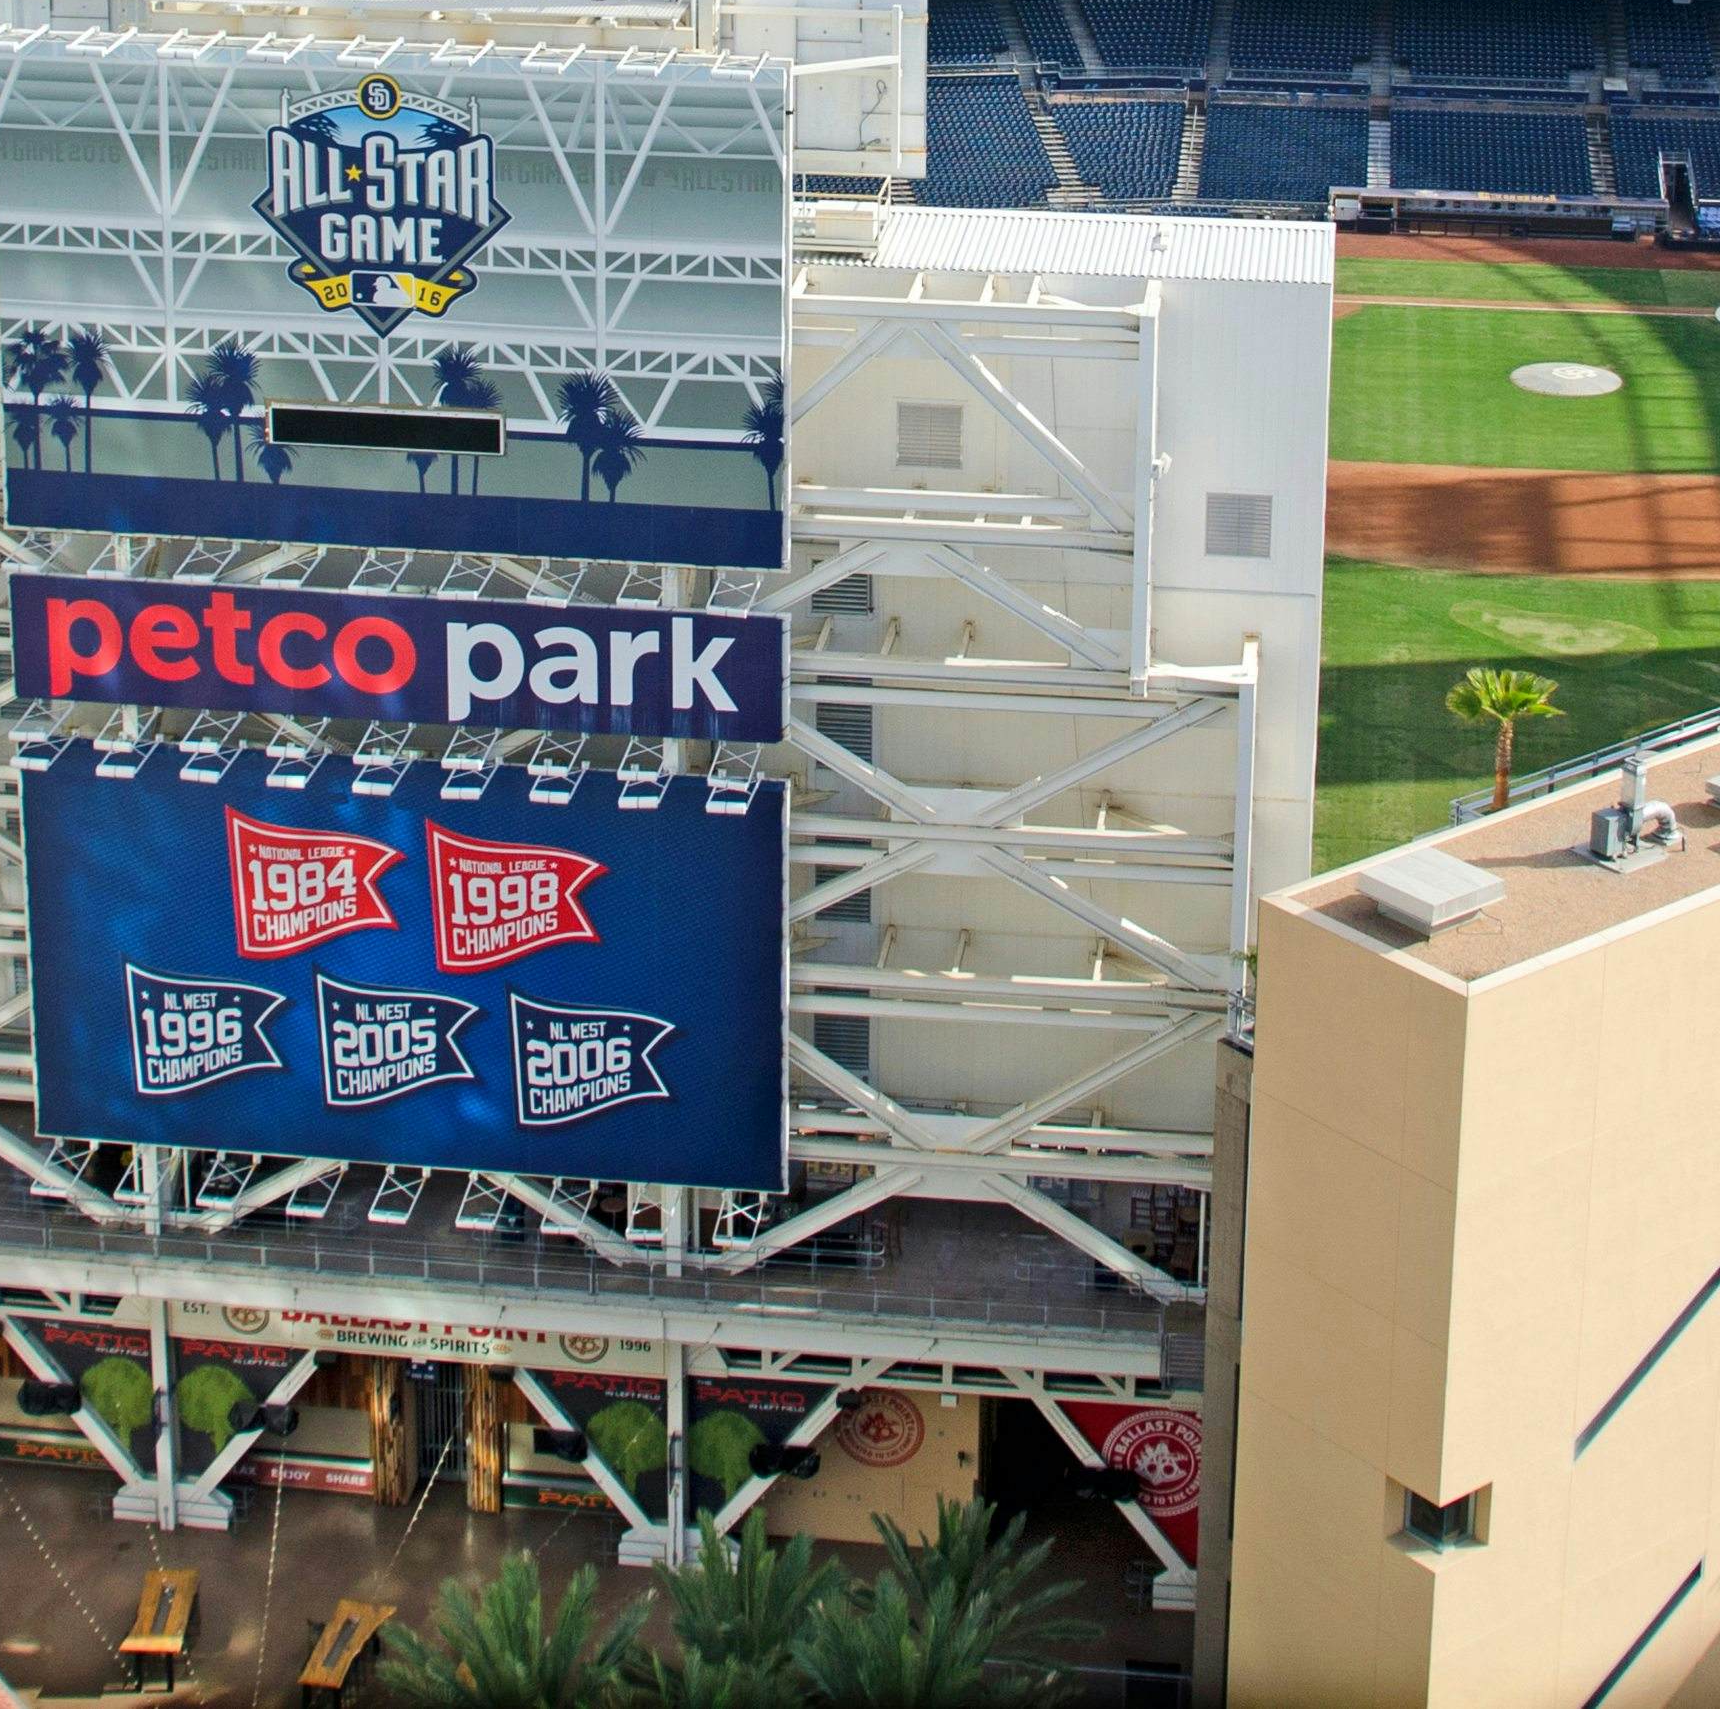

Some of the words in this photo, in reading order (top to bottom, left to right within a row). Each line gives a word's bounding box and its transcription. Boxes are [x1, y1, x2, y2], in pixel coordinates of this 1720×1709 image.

[320, 213, 444, 266] GAME
[46, 592, 417, 696] petco
[447, 616, 739, 722] park
[259, 844, 305, 861] NATIONAL
[308, 845, 346, 860] LEAGUE
[459, 857, 505, 876] NATIONAL
[509, 858, 547, 873] LEAGUE
[248, 858, 357, 912] 1984
[449, 872, 559, 926] 1998
[253, 896, 358, 942] CHAMPIONS
[452, 911, 558, 956] CHAMPIONS
[163, 993, 182, 1010] NL
[183, 992, 218, 1010] WEST
[356, 1003, 373, 1021] NL
[375, 1002, 413, 1021] WEST
[141, 1007, 242, 1056] 1996
[550, 1022, 568, 1040] NL
[569, 1021, 606, 1039] WEST
[333, 1019, 437, 1068] 2005
[146, 1043, 243, 1085] CHAMPIONS
[526, 1038, 632, 1086] 2006
[336, 1054, 436, 1096] CHAMPIONS
[528, 1072, 631, 1115] CHAMPIONS
[183, 1300, 210, 1315] EST.
[42, 1327, 149, 1351] PATIO
[336, 1329, 408, 1348] BREWING
[430, 1339, 491, 1355] SPIRITS
[619, 1339, 652, 1353] 1996
[183, 1342, 287, 1362] PATIO
[552, 1371, 662, 1394] PATIO
[615, 1391, 637, 1399] LEFT
[637, 1392, 662, 1401] FIELD
[696, 1387, 806, 1407] PATIO
[759, 1403, 780, 1411] LEFT
[780, 1404, 805, 1413] FIELD
[1114, 1419, 1176, 1455] BALLAST
[270, 1468, 312, 1482] ENJOY
[325, 1472, 368, 1486] SHARE
